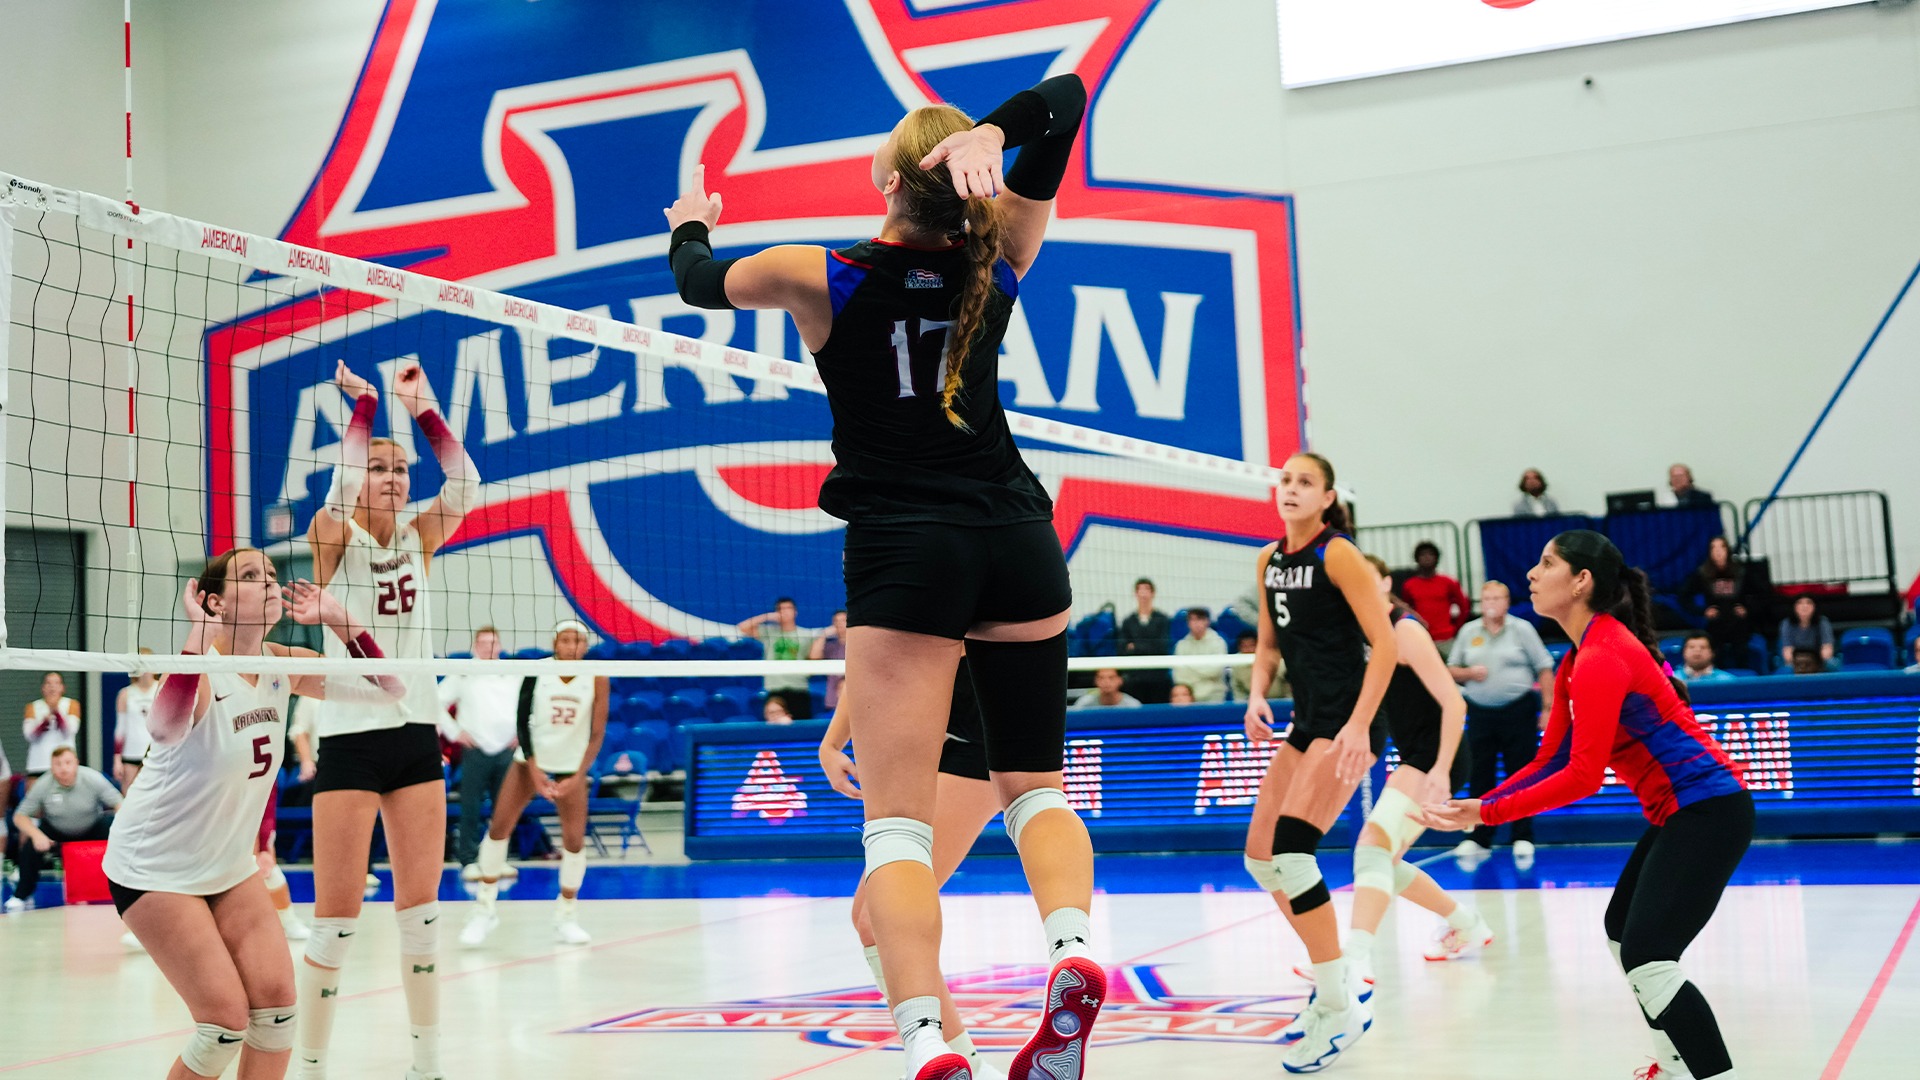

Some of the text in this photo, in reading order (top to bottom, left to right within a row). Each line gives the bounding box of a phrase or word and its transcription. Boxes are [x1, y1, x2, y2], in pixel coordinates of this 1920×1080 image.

[17, 181, 42, 194] Senoh
[201, 226, 249, 259] AMERICAN
[287, 247, 331, 277] AMERICAN
[366, 266, 406, 294] AMERICAN
[437, 283, 475, 310] AMERICAN
[503, 298, 539, 324] AMERICAN
[889, 317, 959, 399] 17
[278, 284, 1205, 504] AMERIAN
[377, 573, 417, 616] 26
[1274, 592, 1291, 628] 5
[551, 705, 577, 726] 22
[247, 734, 273, 780] 5
